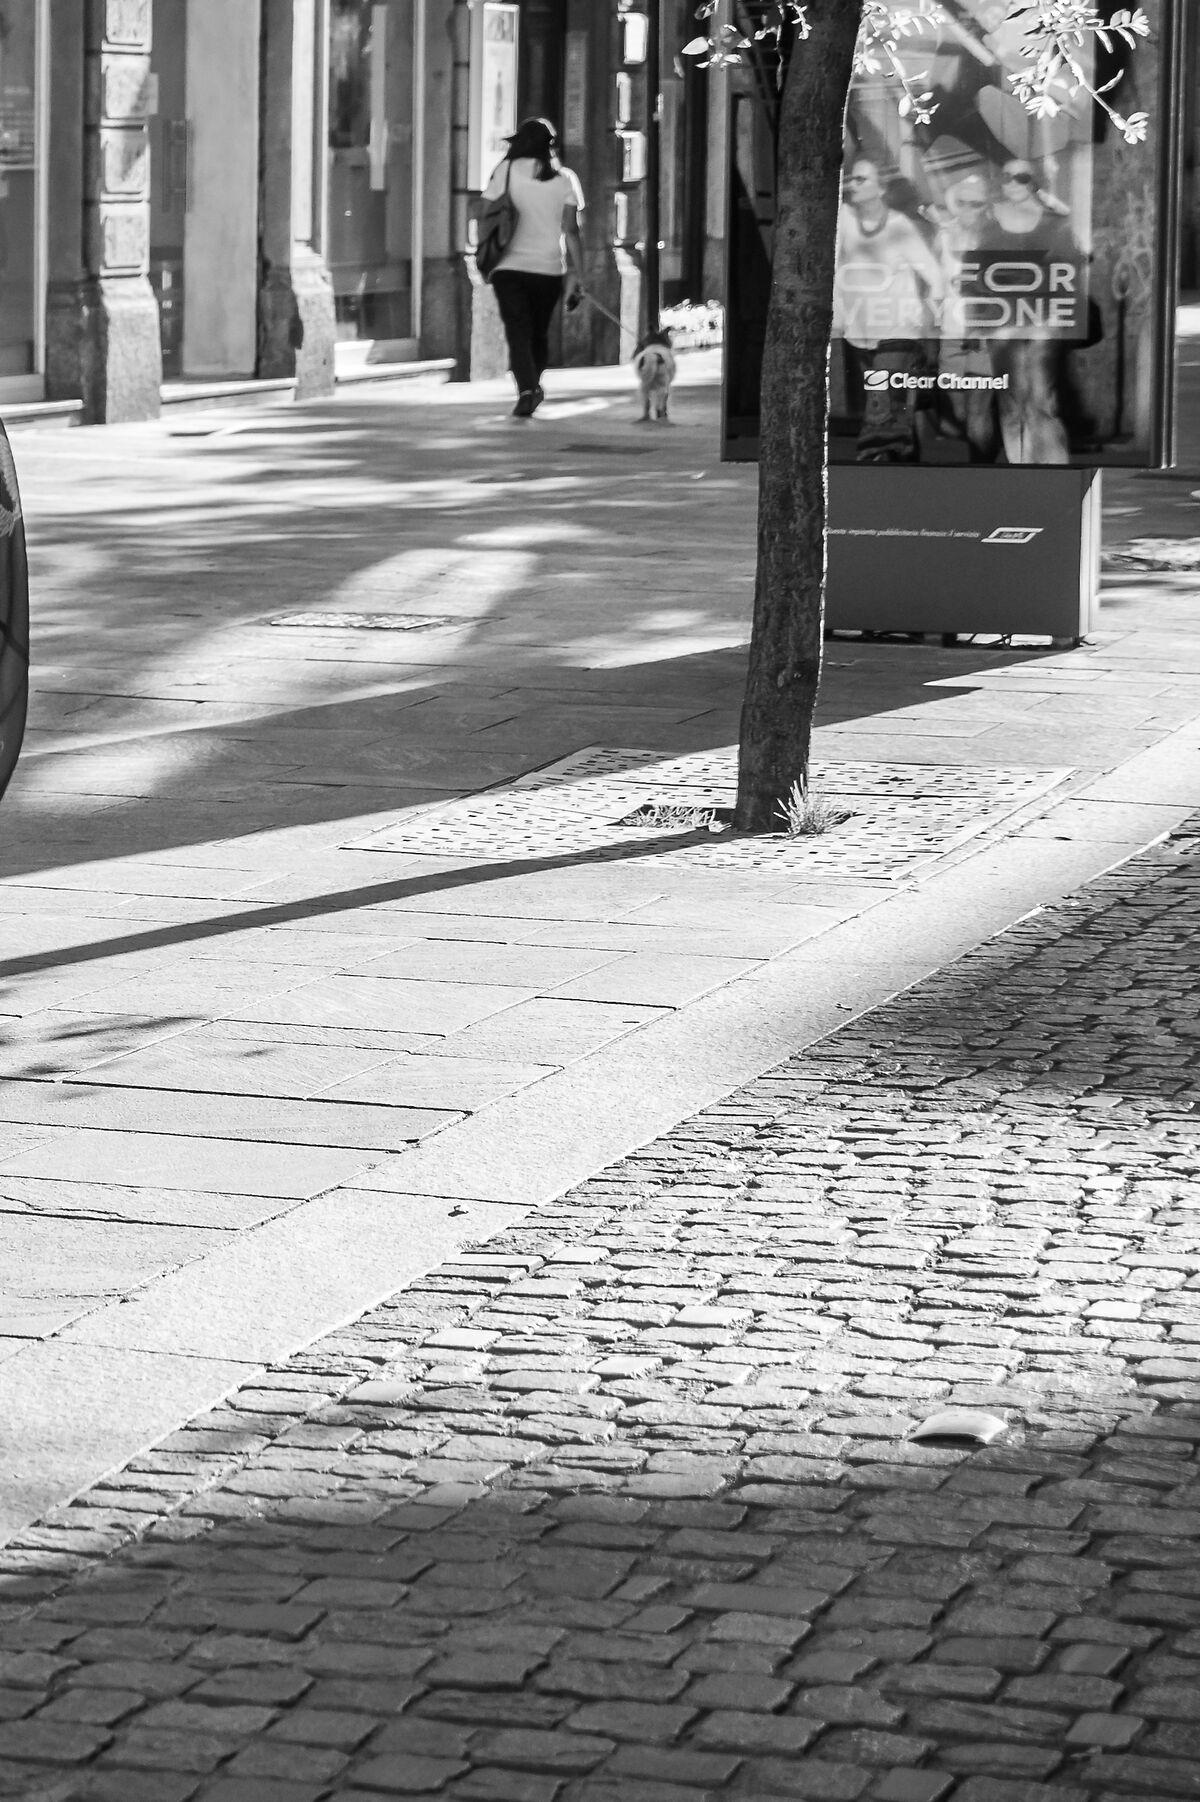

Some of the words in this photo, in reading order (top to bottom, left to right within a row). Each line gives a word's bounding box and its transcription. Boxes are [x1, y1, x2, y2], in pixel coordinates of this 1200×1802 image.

[957, 261, 1077, 293] FOR
[840, 297, 1077, 328] VERYONE
[889, 372, 936, 390] Clear
[937, 372, 1009, 390] Channel
